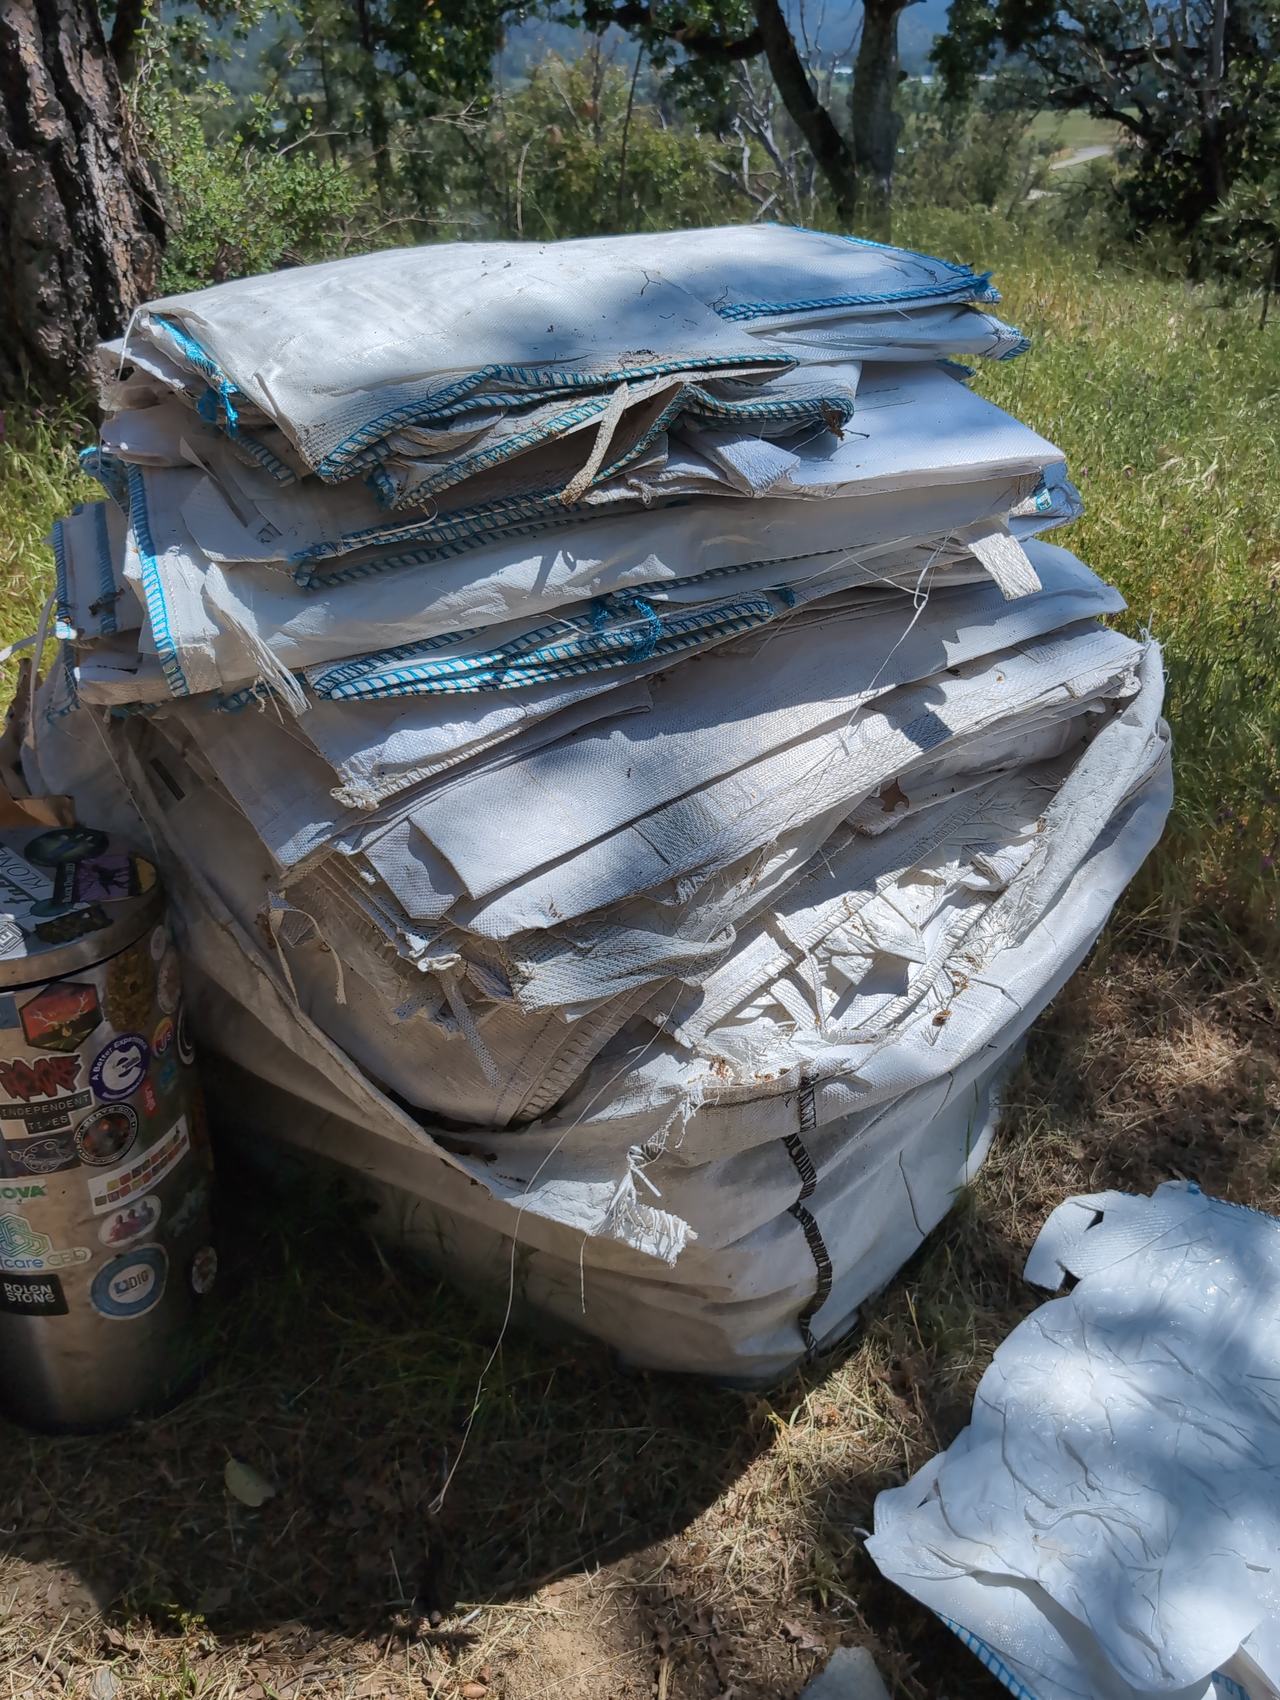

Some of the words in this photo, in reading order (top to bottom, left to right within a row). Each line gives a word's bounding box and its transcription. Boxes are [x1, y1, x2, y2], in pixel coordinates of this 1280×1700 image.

[1, 1093, 90, 1117] INDEPENDENT
[0, 1185, 45, 1199] OVA
[47, 1249, 87, 1267] CBD
